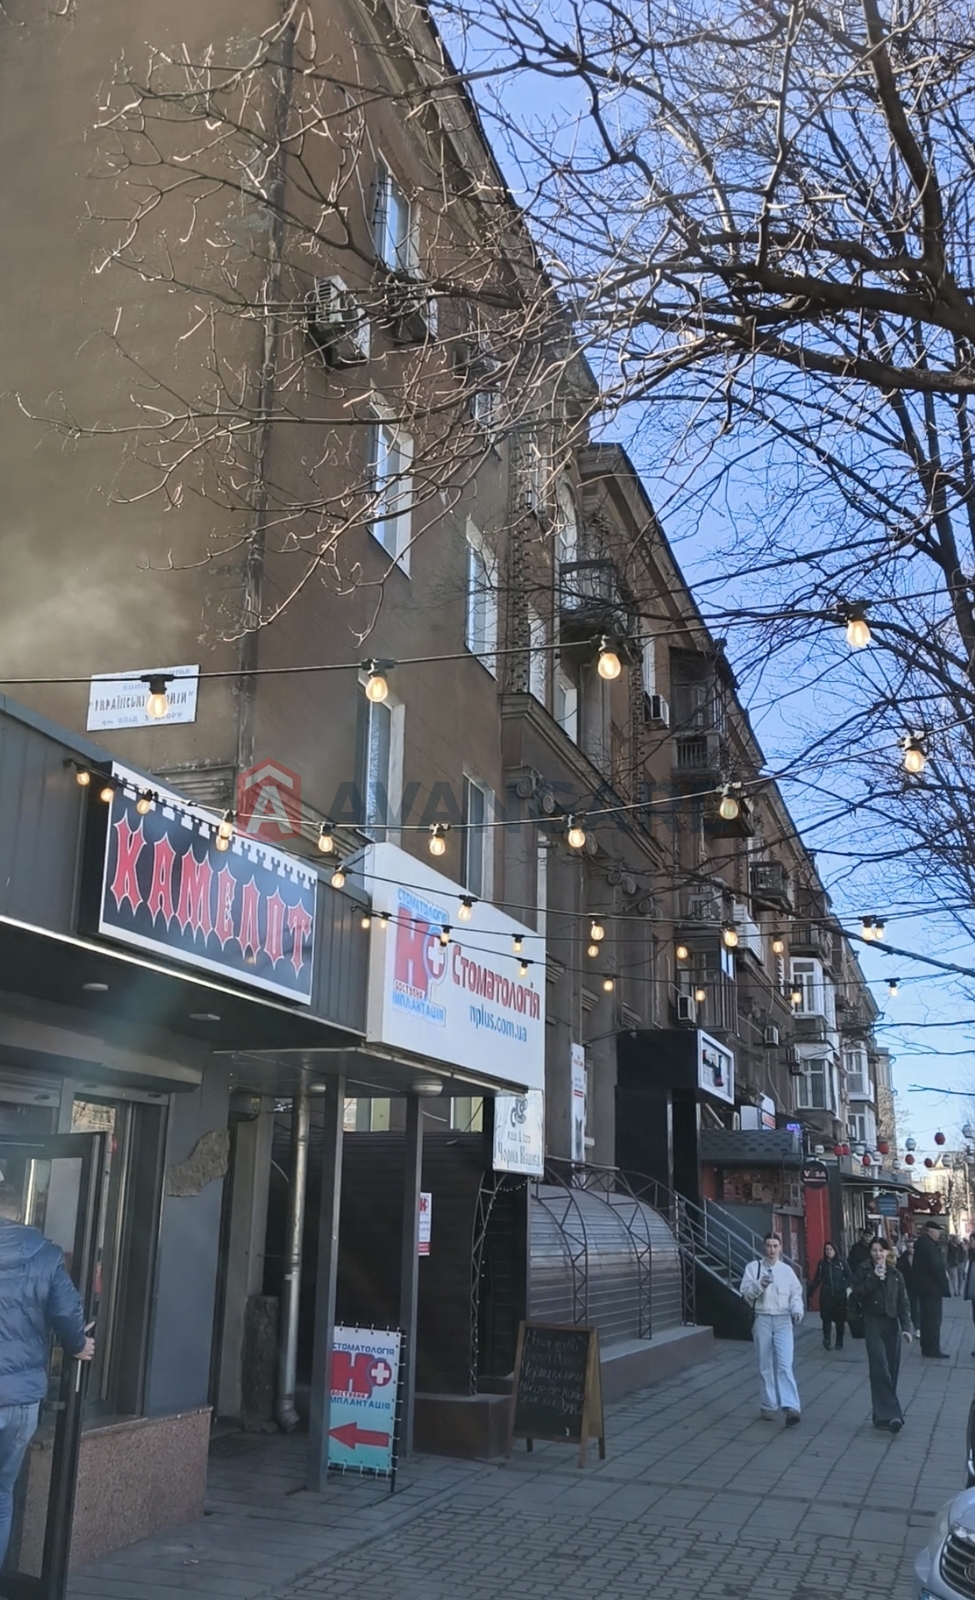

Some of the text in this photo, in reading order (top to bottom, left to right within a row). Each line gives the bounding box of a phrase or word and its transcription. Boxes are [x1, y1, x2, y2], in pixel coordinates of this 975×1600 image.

[110, 808, 313, 979] КАМЕЛОТ
[452, 944, 540, 1020] Стоматологія
[470, 1004, 527, 1042] nplus.com.ua
[332, 1342, 395, 1356] СТОМАТОЛОГІЯ
